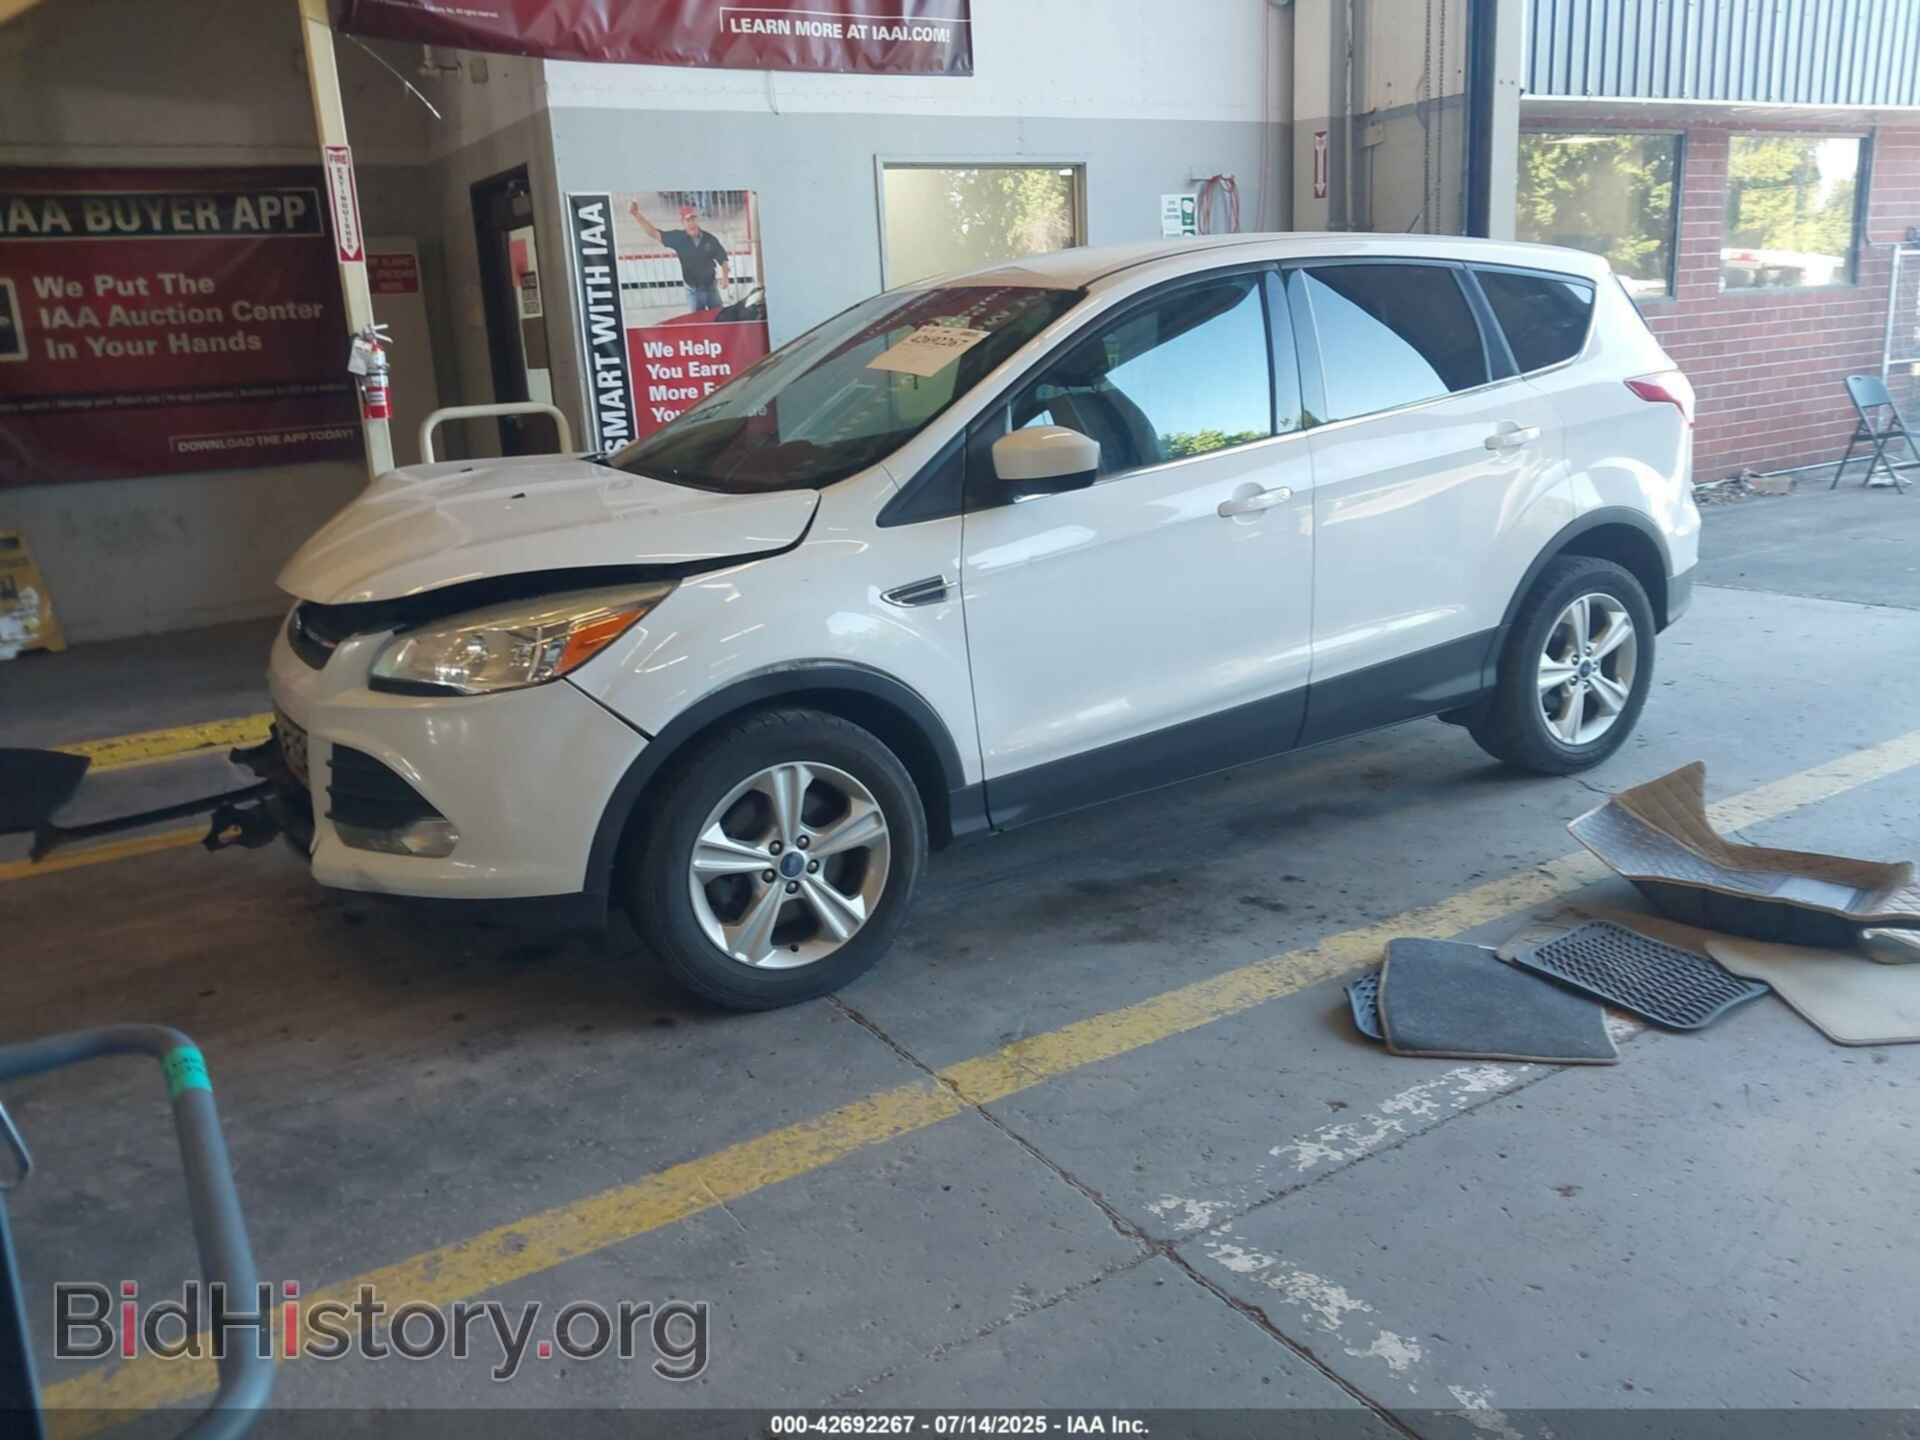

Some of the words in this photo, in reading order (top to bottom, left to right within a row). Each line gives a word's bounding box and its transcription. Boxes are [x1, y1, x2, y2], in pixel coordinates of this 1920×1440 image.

[730, 18, 790, 35] LEARN
[795, 20, 843, 39] MORE
[846, 24, 868, 39] AT
[872, 25, 951, 43] IAAI.COM!
[84, 196, 221, 232] BUYER
[232, 195, 306, 230] APP
[578, 202, 608, 256] IAA
[33, 275, 83, 299] We
[95, 274, 149, 297] Put
[157, 272, 216, 295] The
[40, 306, 99, 330] IAA
[108, 303, 224, 327] Auction
[232, 301, 324, 322] Center
[584, 265, 618, 345] WITH
[46, 338, 78, 360] In
[86, 336, 158, 358] Your
[168, 332, 263, 355] Hands
[643, 341, 674, 358] We
[679, 339, 722, 358] Help
[646, 363, 683, 380] You
[688, 361, 731, 377] Earn
[594, 352, 630, 455] SMART
[649, 384, 698, 402] More
[178, 436, 256, 452] DOWNLOAD
[257, 434, 282, 446] THE
[283, 432, 307, 444] APP
